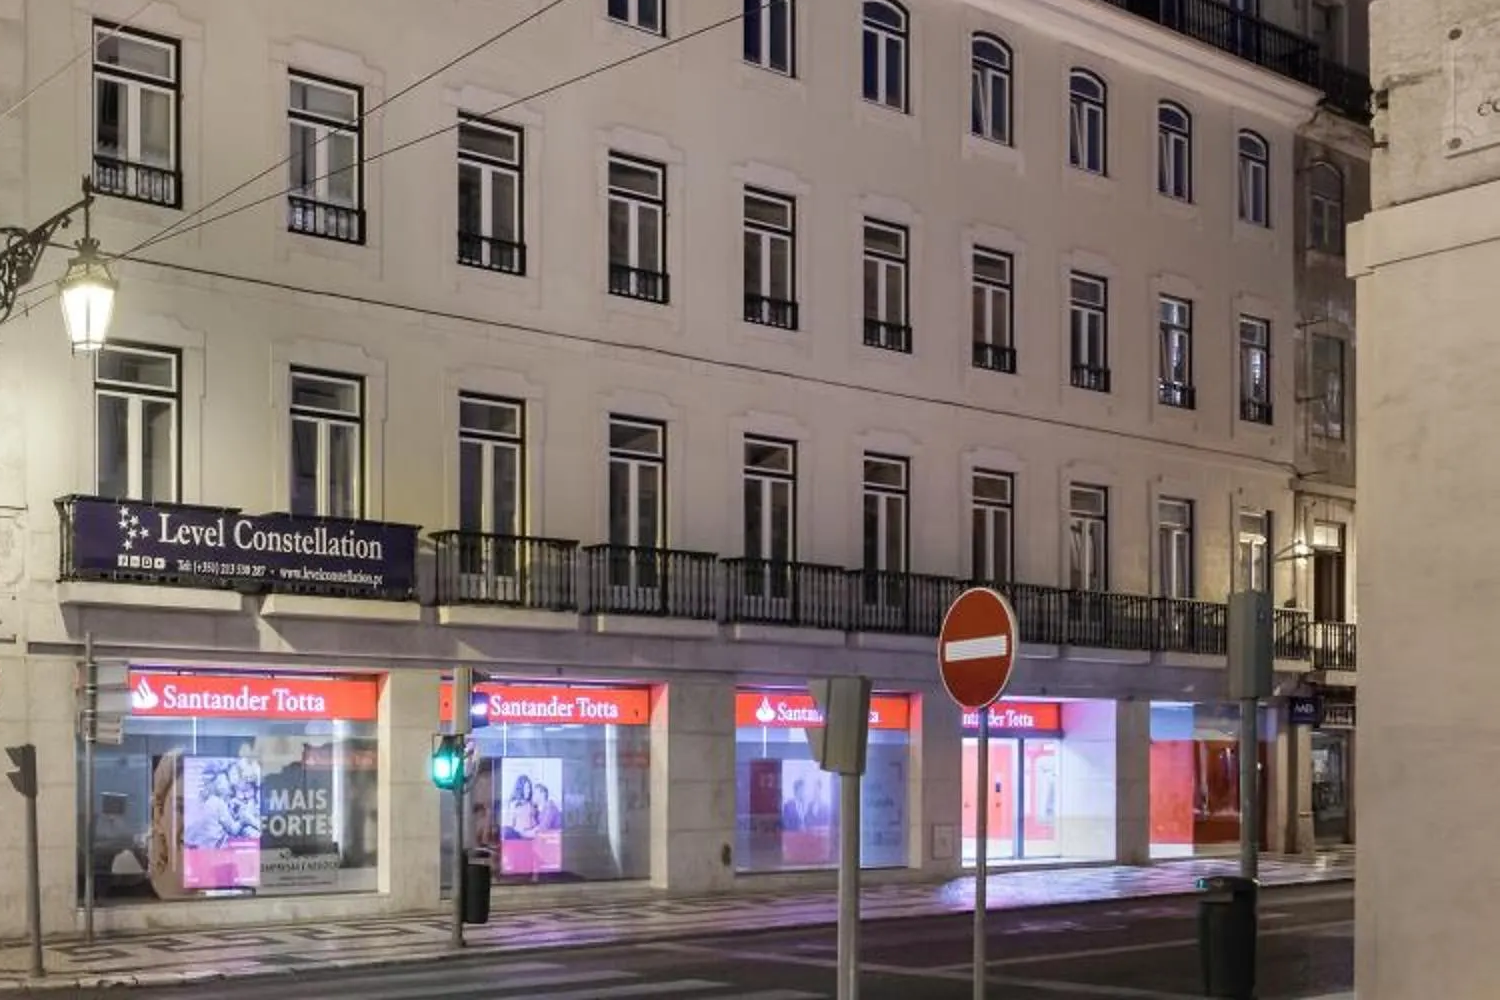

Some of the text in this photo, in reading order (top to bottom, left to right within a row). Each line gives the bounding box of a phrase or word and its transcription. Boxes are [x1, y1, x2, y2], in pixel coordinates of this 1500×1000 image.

[157, 512, 383, 561] Level Constellation
[163, 684, 326, 713] Santander Totta
[490, 694, 618, 719] Santander Totta
[1005, 709, 1034, 728] Totta
[269, 788, 328, 812] MAIS
